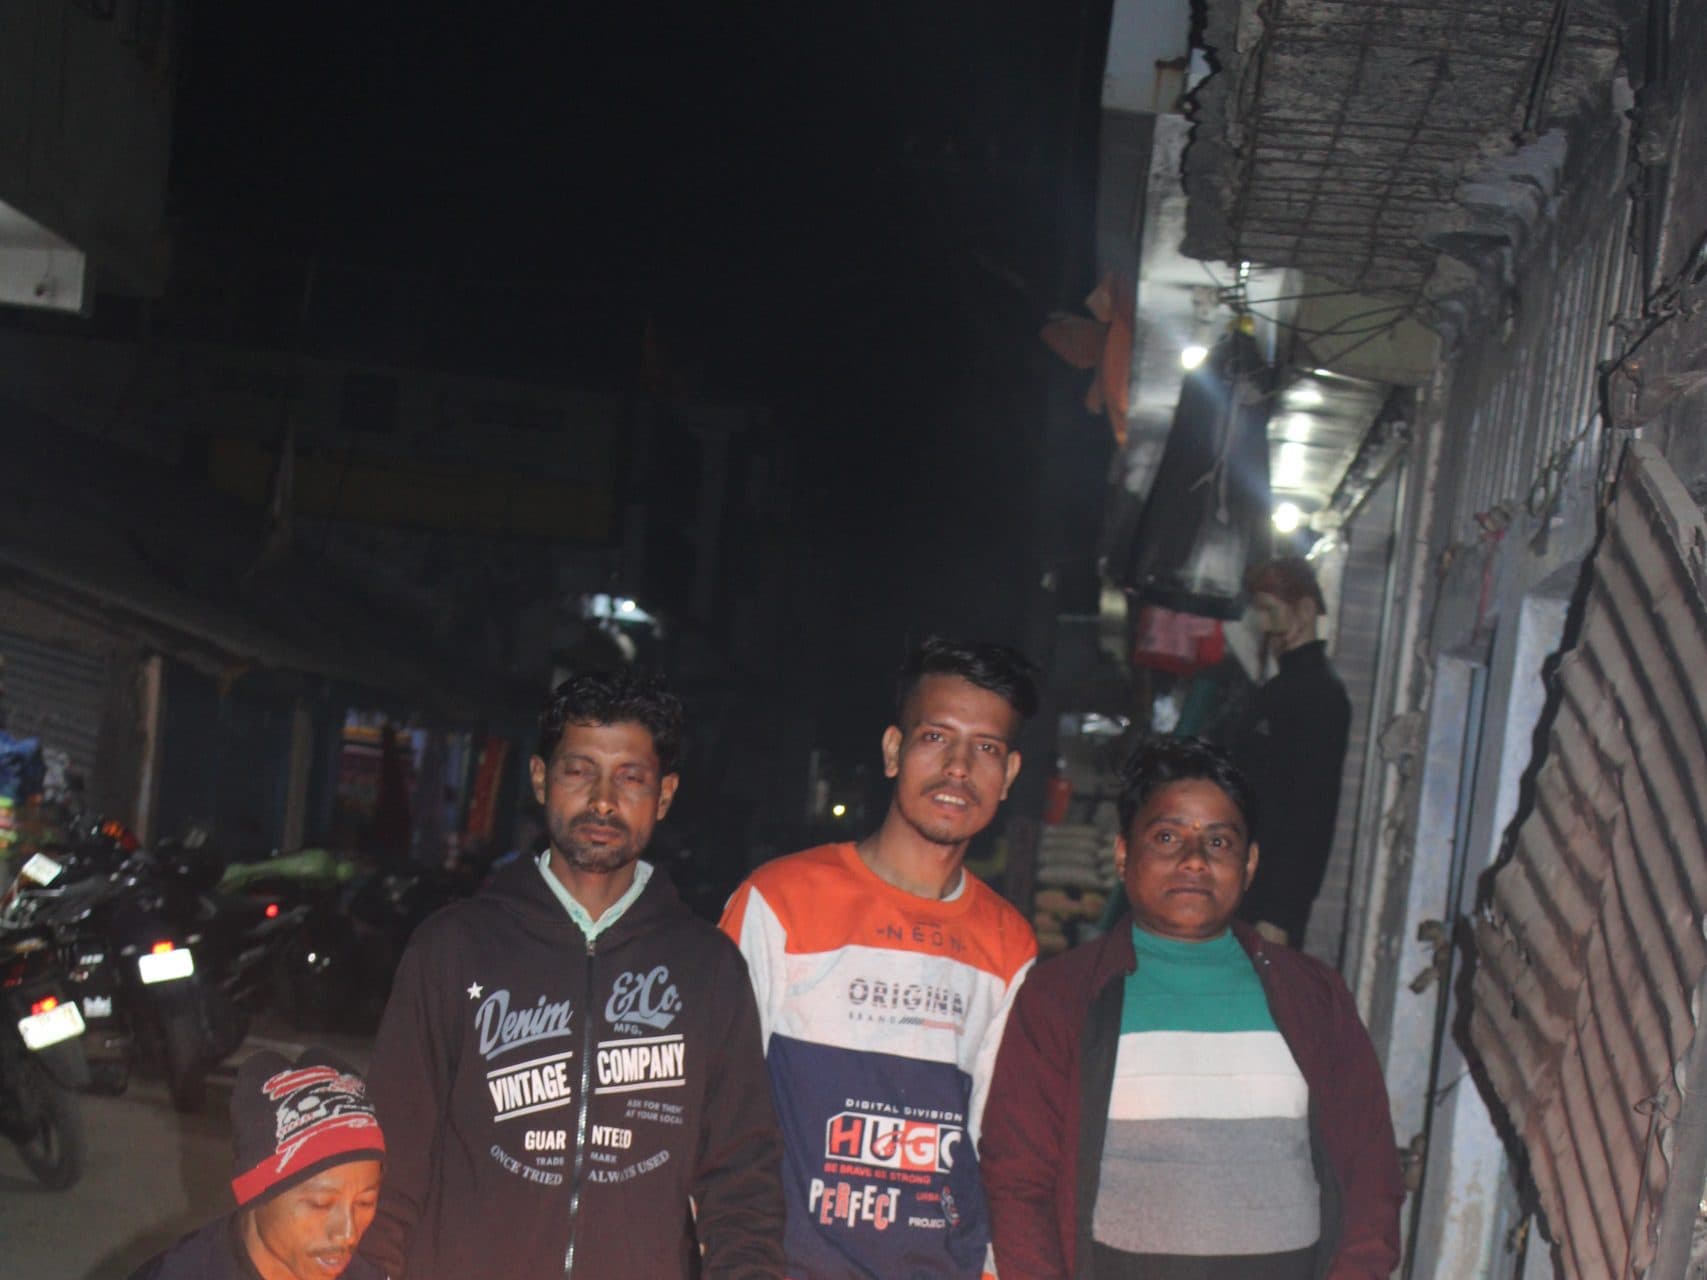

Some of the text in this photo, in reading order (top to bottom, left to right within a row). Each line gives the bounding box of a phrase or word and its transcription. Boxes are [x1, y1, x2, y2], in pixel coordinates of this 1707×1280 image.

[475, 989, 574, 1056] Denim
[488, 1043, 685, 1113] VINTAGE COMPANY
[625, 1109, 636, 1118] AT
[637, 1110, 658, 1121] YOUR
[643, 1100, 659, 1110] FOR
[845, 1098, 963, 1122] DIGITAL DIVISION
[524, 1130, 567, 1151] GUAR
[490, 1144, 522, 1174] ONCE
[522, 1165, 563, 1187] TRIED
[636, 1150, 670, 1174] USED
[536, 1151, 616, 1167] TRADE MARK
[839, 1163, 872, 1177] BRAVE
[890, 1172, 931, 1185] STRONG
[809, 1178, 901, 1230] PERFECT
